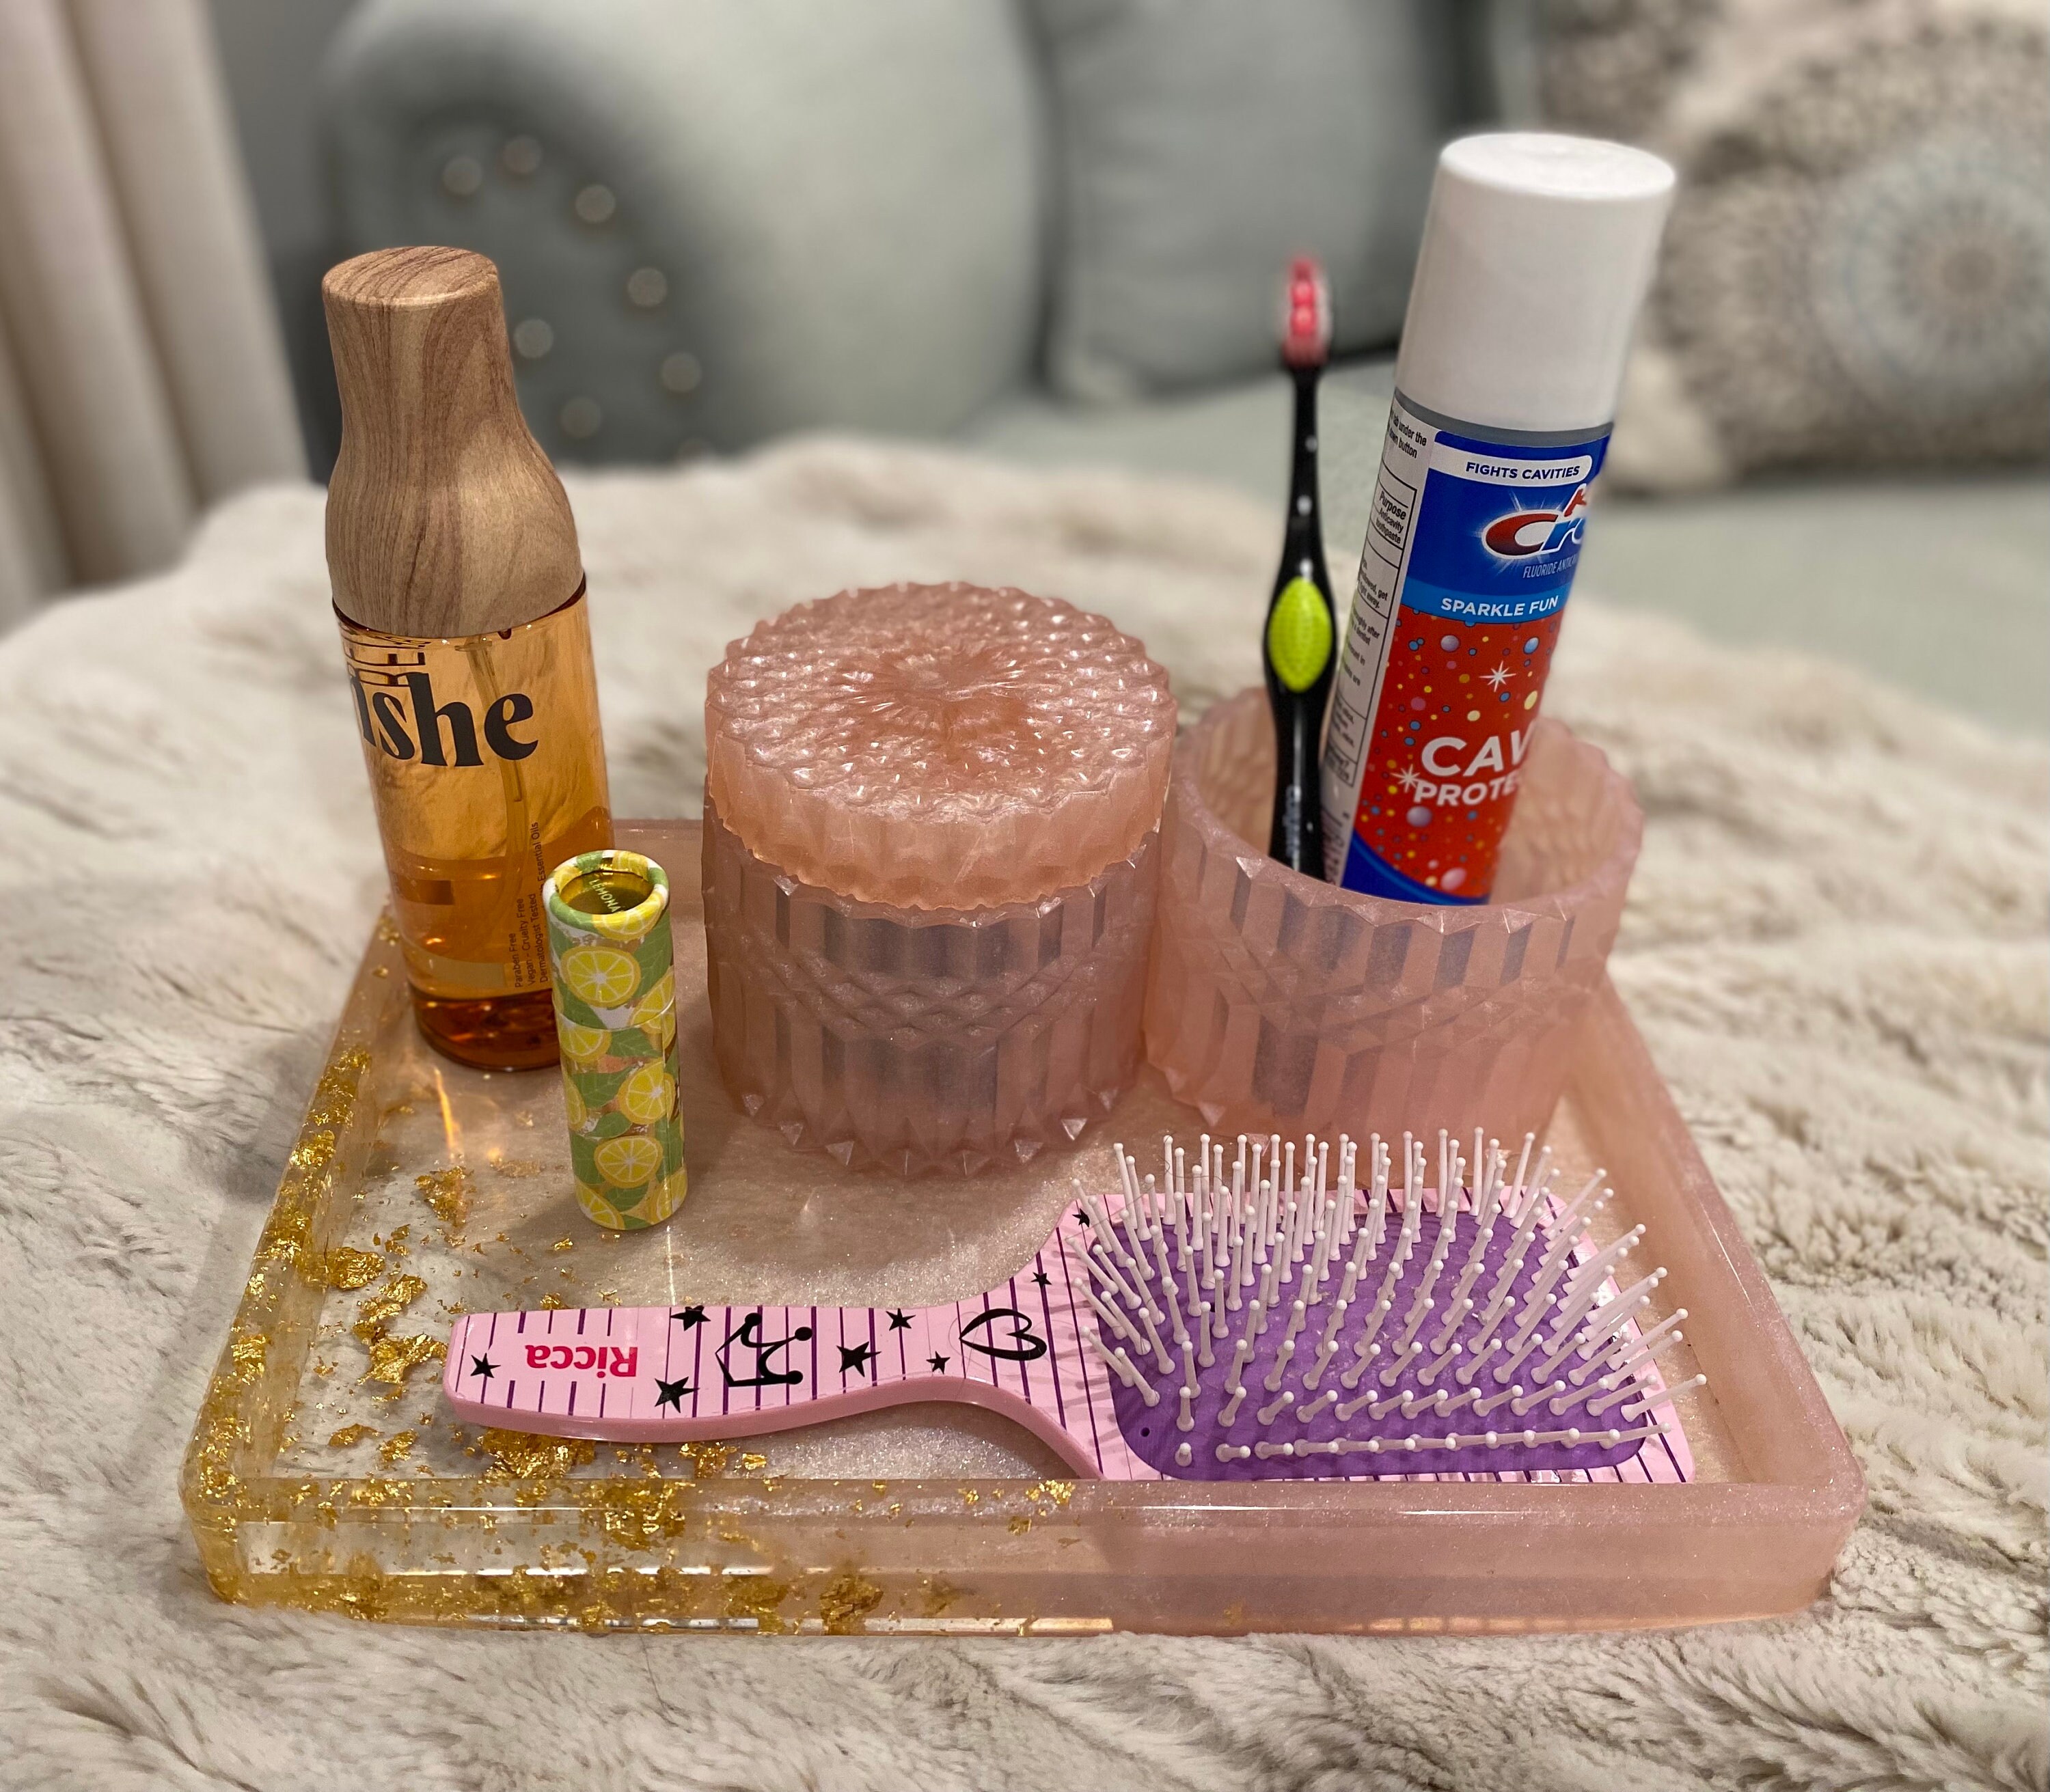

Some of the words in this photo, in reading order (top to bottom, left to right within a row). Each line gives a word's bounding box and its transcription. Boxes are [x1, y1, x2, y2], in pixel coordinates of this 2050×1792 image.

[1399, 421, 1414, 439] under
[1415, 431, 1427, 446] the
[1398, 437, 1418, 458] button
[1466, 462, 1518, 478] FIGHTS
[1522, 465, 1581, 479] CAVITIES
[1379, 491, 1406, 519] Purpose
[1522, 562, 1558, 579] FLUORIDE
[1378, 590, 1388, 601] get
[1440, 598, 1525, 617] SPARKLE
[1528, 595, 1559, 614] FUN
[530, 822, 541, 840] Oils
[533, 842, 546, 881] Essential
[517, 898, 525, 919] Free
[528, 893, 539, 922] Tested
[589, 879, 623, 913] LEMONA
[508, 933, 517, 952] Free
[519, 920, 531, 951] Cruelty
[532, 924, 548, 982] Dermatologist
[515, 954, 523, 988] Paraben
[526, 959, 536, 986] Vegan
[525, 1345, 638, 1379] Ricca
